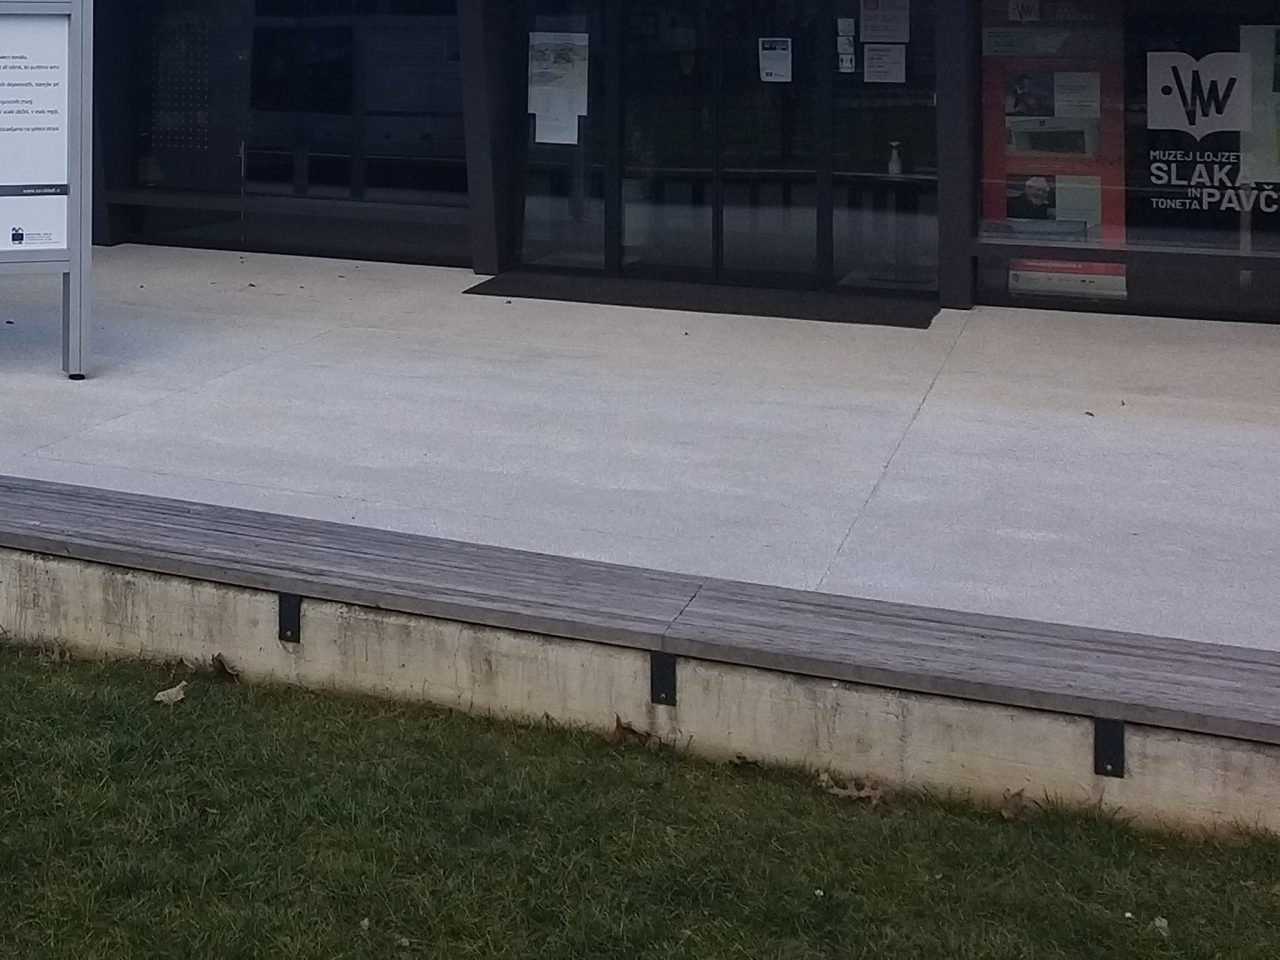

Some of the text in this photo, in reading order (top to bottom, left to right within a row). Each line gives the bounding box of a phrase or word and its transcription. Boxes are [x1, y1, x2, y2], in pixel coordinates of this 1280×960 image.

[1149, 150, 1246, 162] MUZEJ LOJZET
[1150, 162, 1256, 188] SLAKA
[1150, 184, 1280, 213] TONETA PAVČ
[1187, 187, 1200, 198] IN
